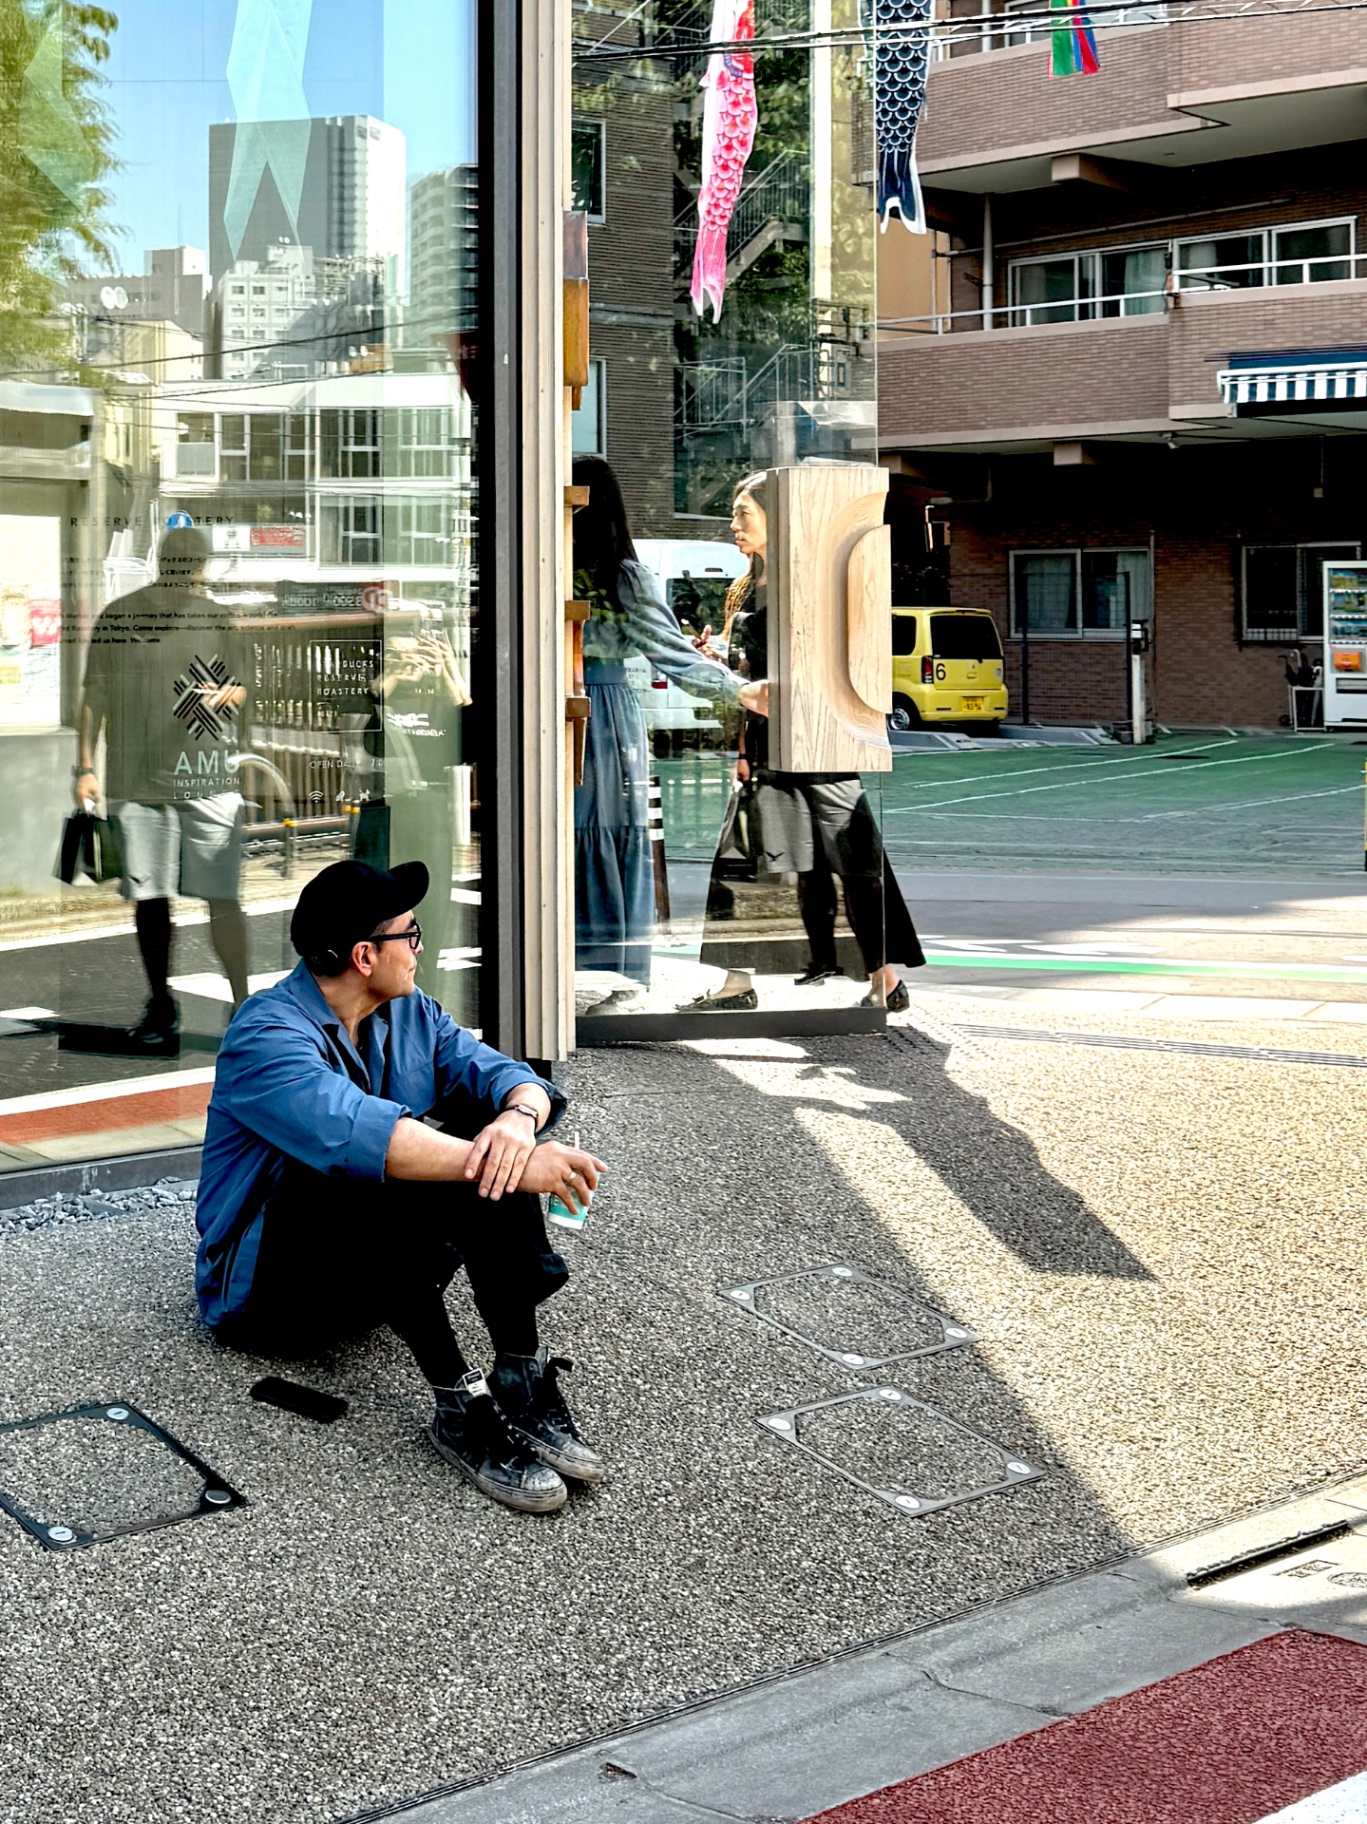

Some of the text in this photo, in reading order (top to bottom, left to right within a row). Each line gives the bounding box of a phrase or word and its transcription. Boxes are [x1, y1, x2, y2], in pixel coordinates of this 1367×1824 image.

[935, 662, 946, 681] 6
[173, 750, 240, 775] AMU
[173, 777, 240, 788] INSPIRATION
